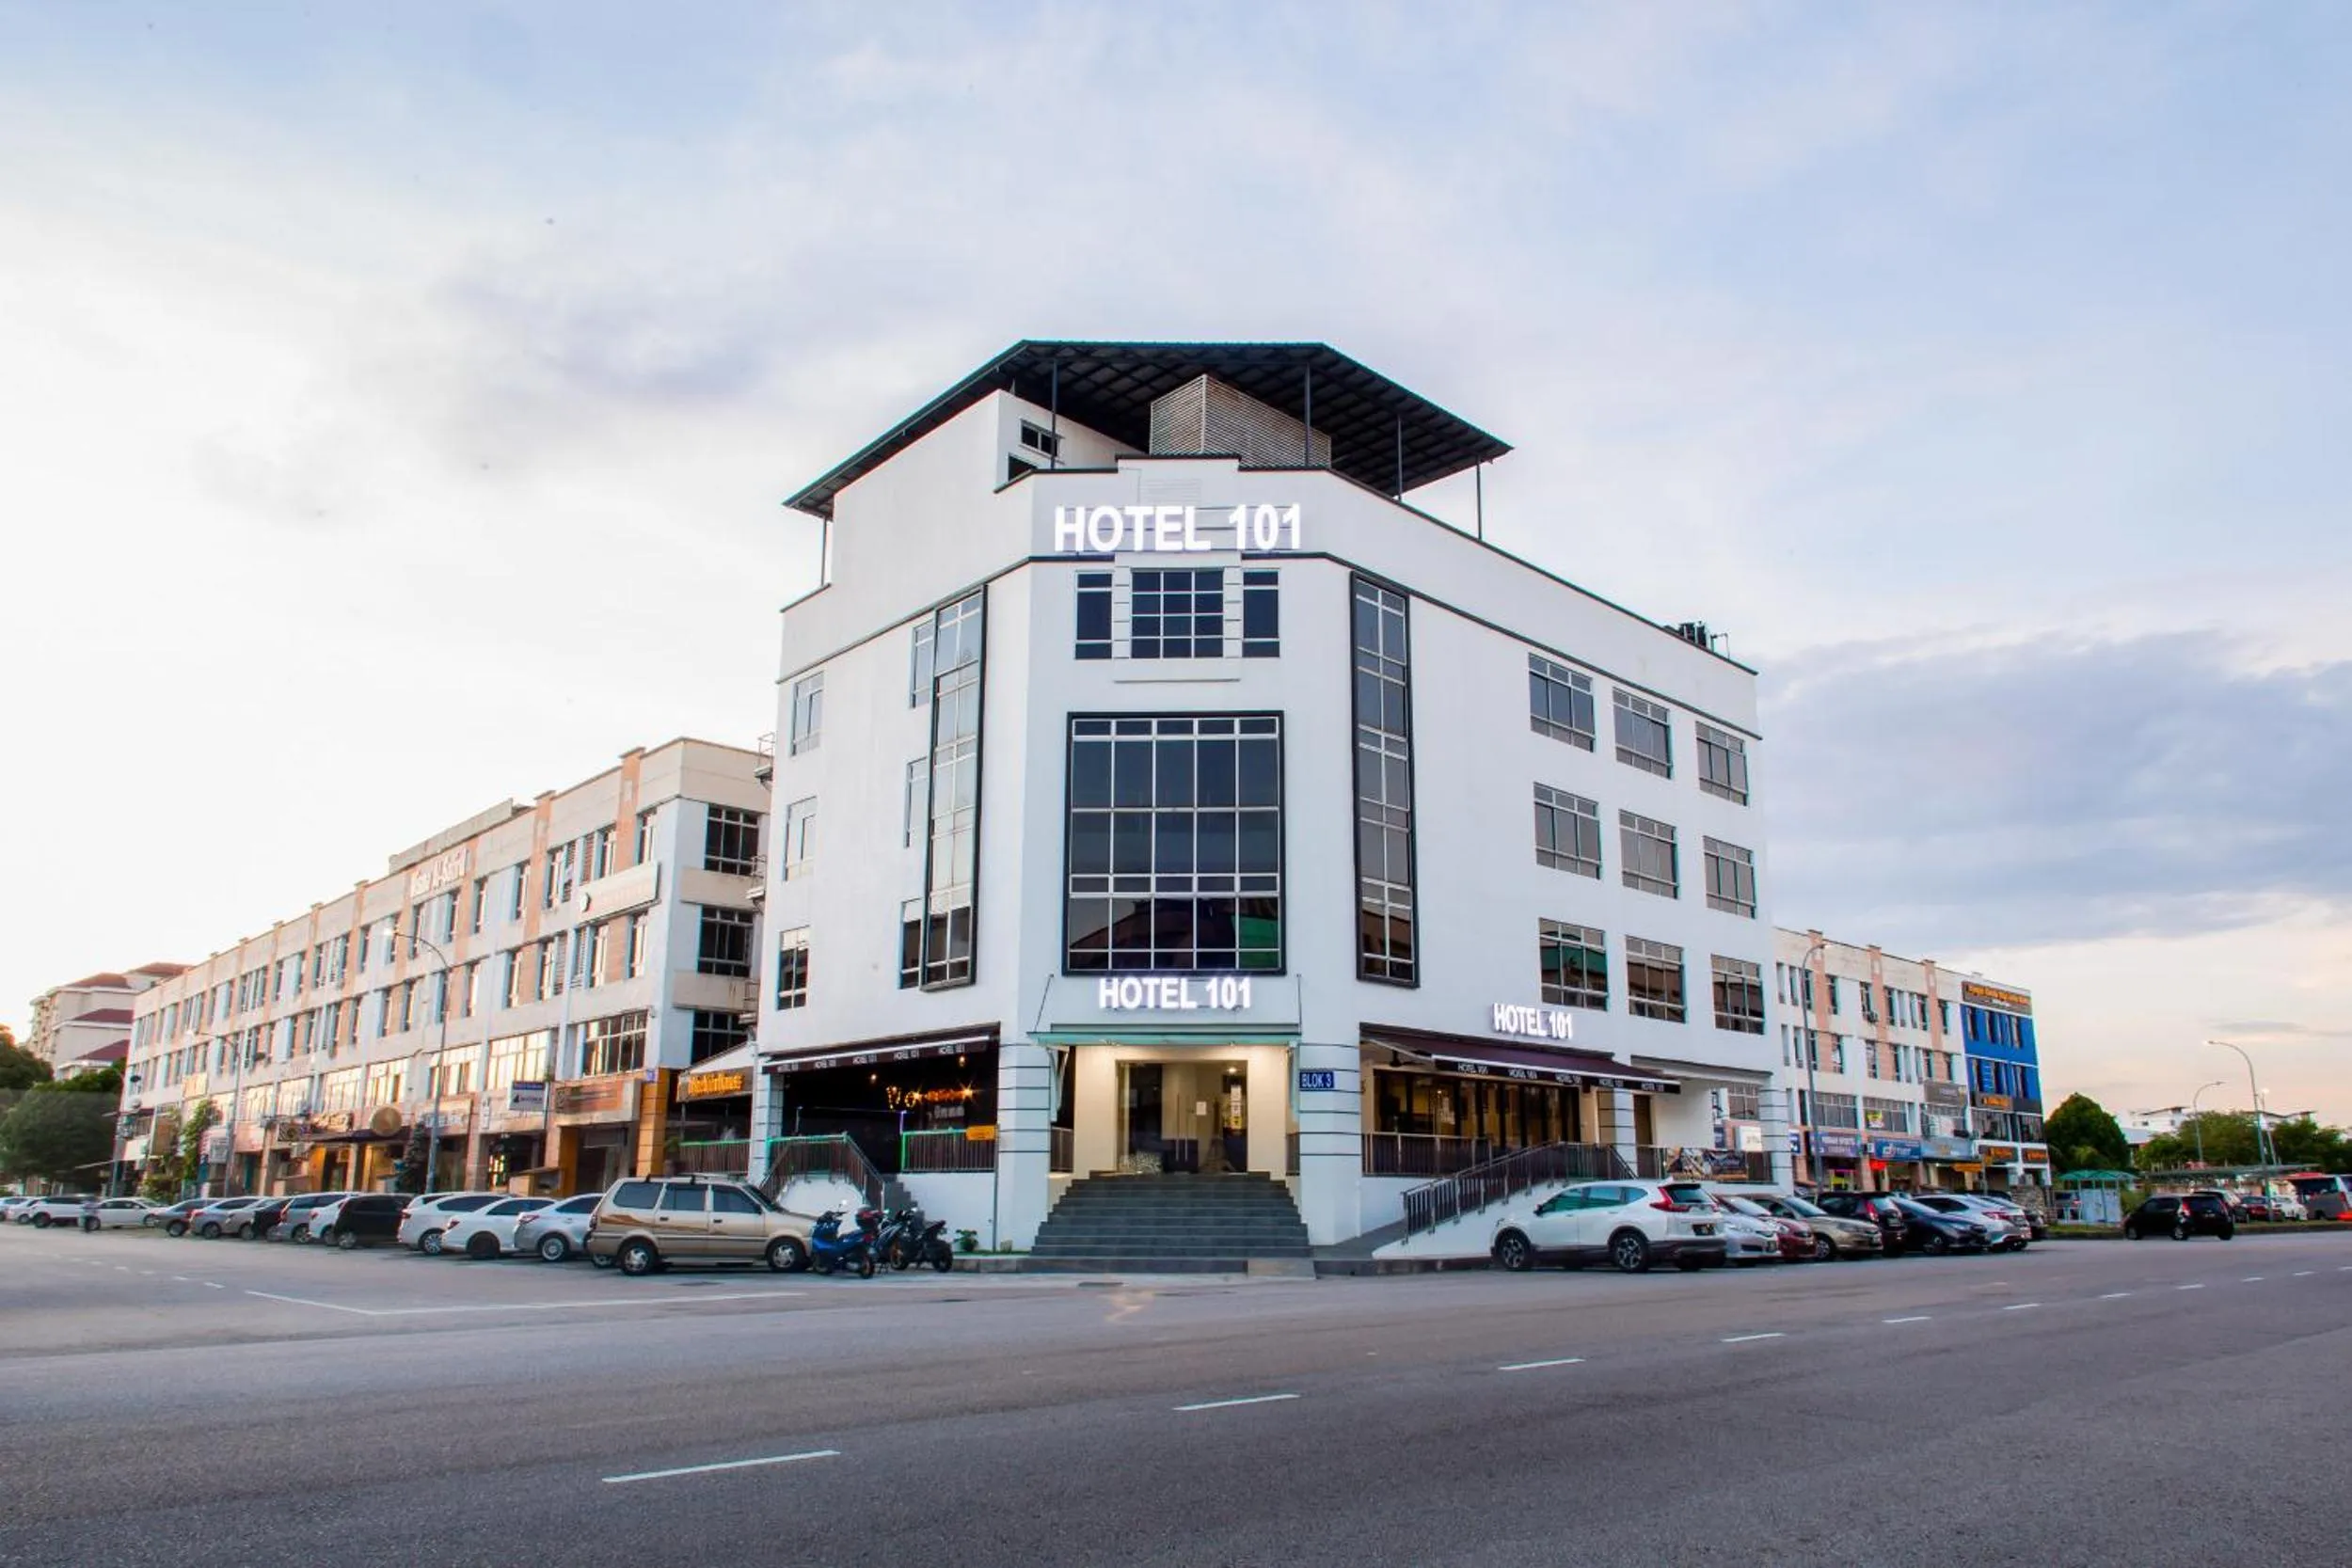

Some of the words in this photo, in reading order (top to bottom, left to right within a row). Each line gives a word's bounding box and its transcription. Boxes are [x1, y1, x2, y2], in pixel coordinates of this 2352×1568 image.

[1055, 505, 1211, 552] HOTEL
[1229, 503, 1301, 550] 101
[1099, 976, 1198, 1009] HOTEL
[1205, 975, 1251, 1009] 101
[1493, 1003, 1548, 1037] HOTEL
[1549, 1010, 1573, 1038] 101
[1301, 1073, 1324, 1088] BLOK
[1326, 1073, 1332, 1088] 3
